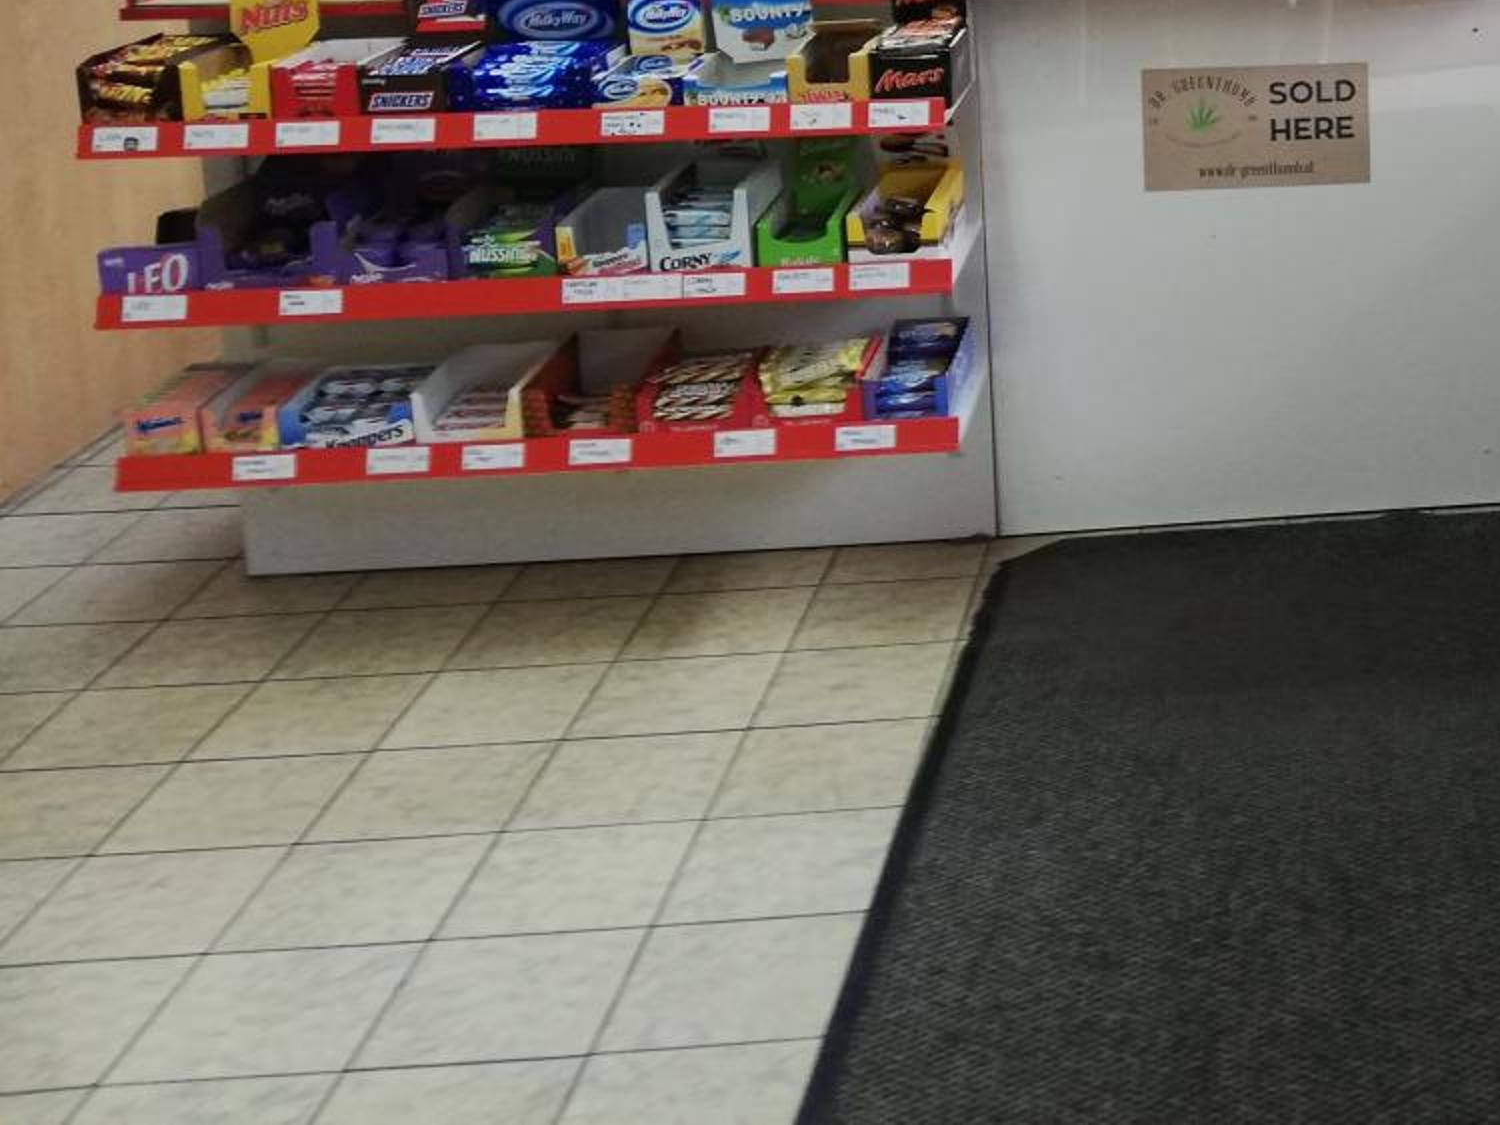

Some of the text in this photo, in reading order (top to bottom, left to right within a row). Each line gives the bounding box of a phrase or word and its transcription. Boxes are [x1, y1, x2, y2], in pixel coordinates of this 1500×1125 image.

[730, 6, 804, 23] BOUNTY
[874, 67, 945, 93] Mars
[371, 94, 430, 109] SNICKERS
[697, 91, 762, 106] BOUNTY
[1269, 79, 1356, 104] SOLD
[1269, 116, 1355, 141] HERE
[659, 252, 712, 272] CORNY
